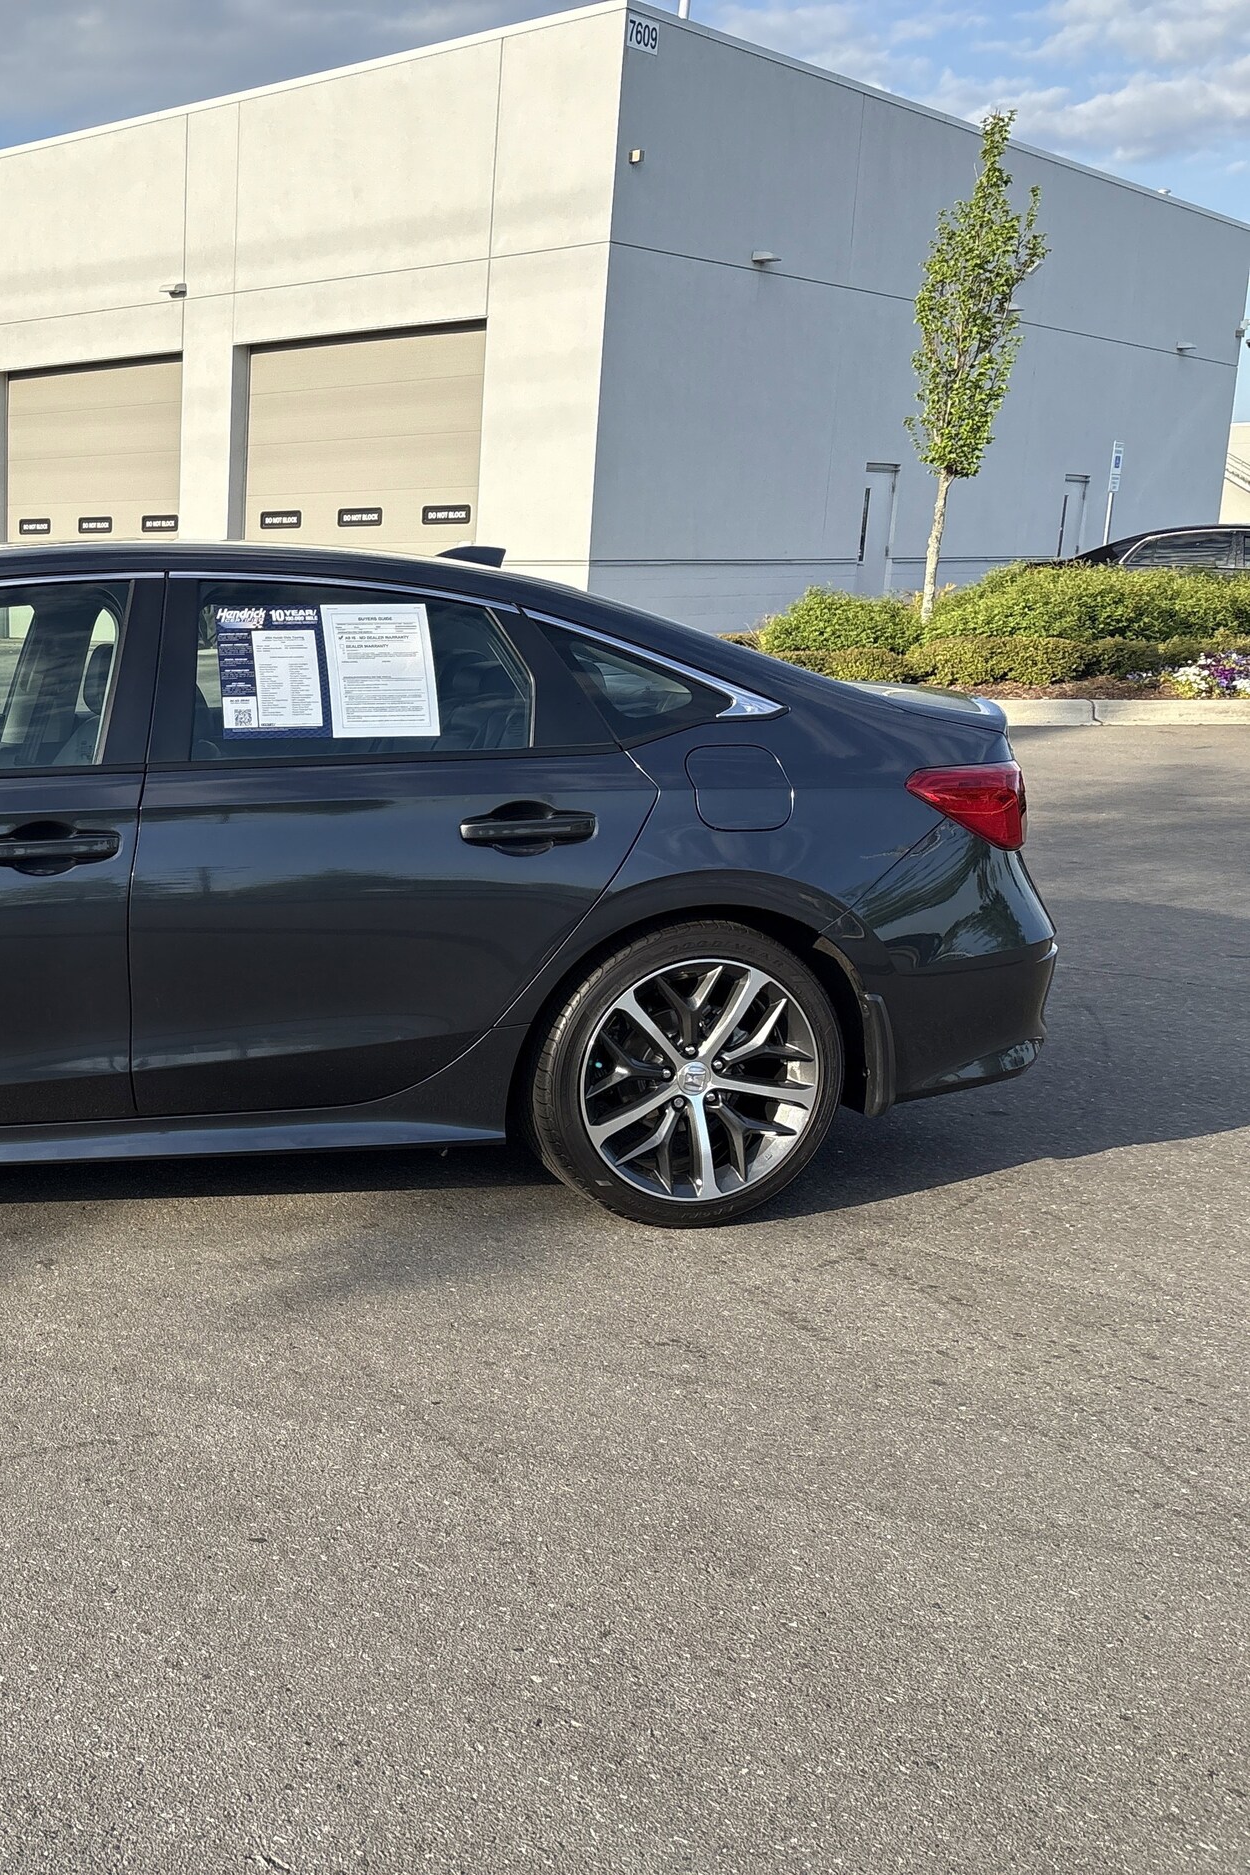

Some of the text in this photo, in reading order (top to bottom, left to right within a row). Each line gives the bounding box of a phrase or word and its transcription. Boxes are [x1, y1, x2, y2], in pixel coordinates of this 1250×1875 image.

[629, 19, 658, 50] 7609
[216, 608, 266, 622] Hendrick
[269, 609, 284, 621] 10
